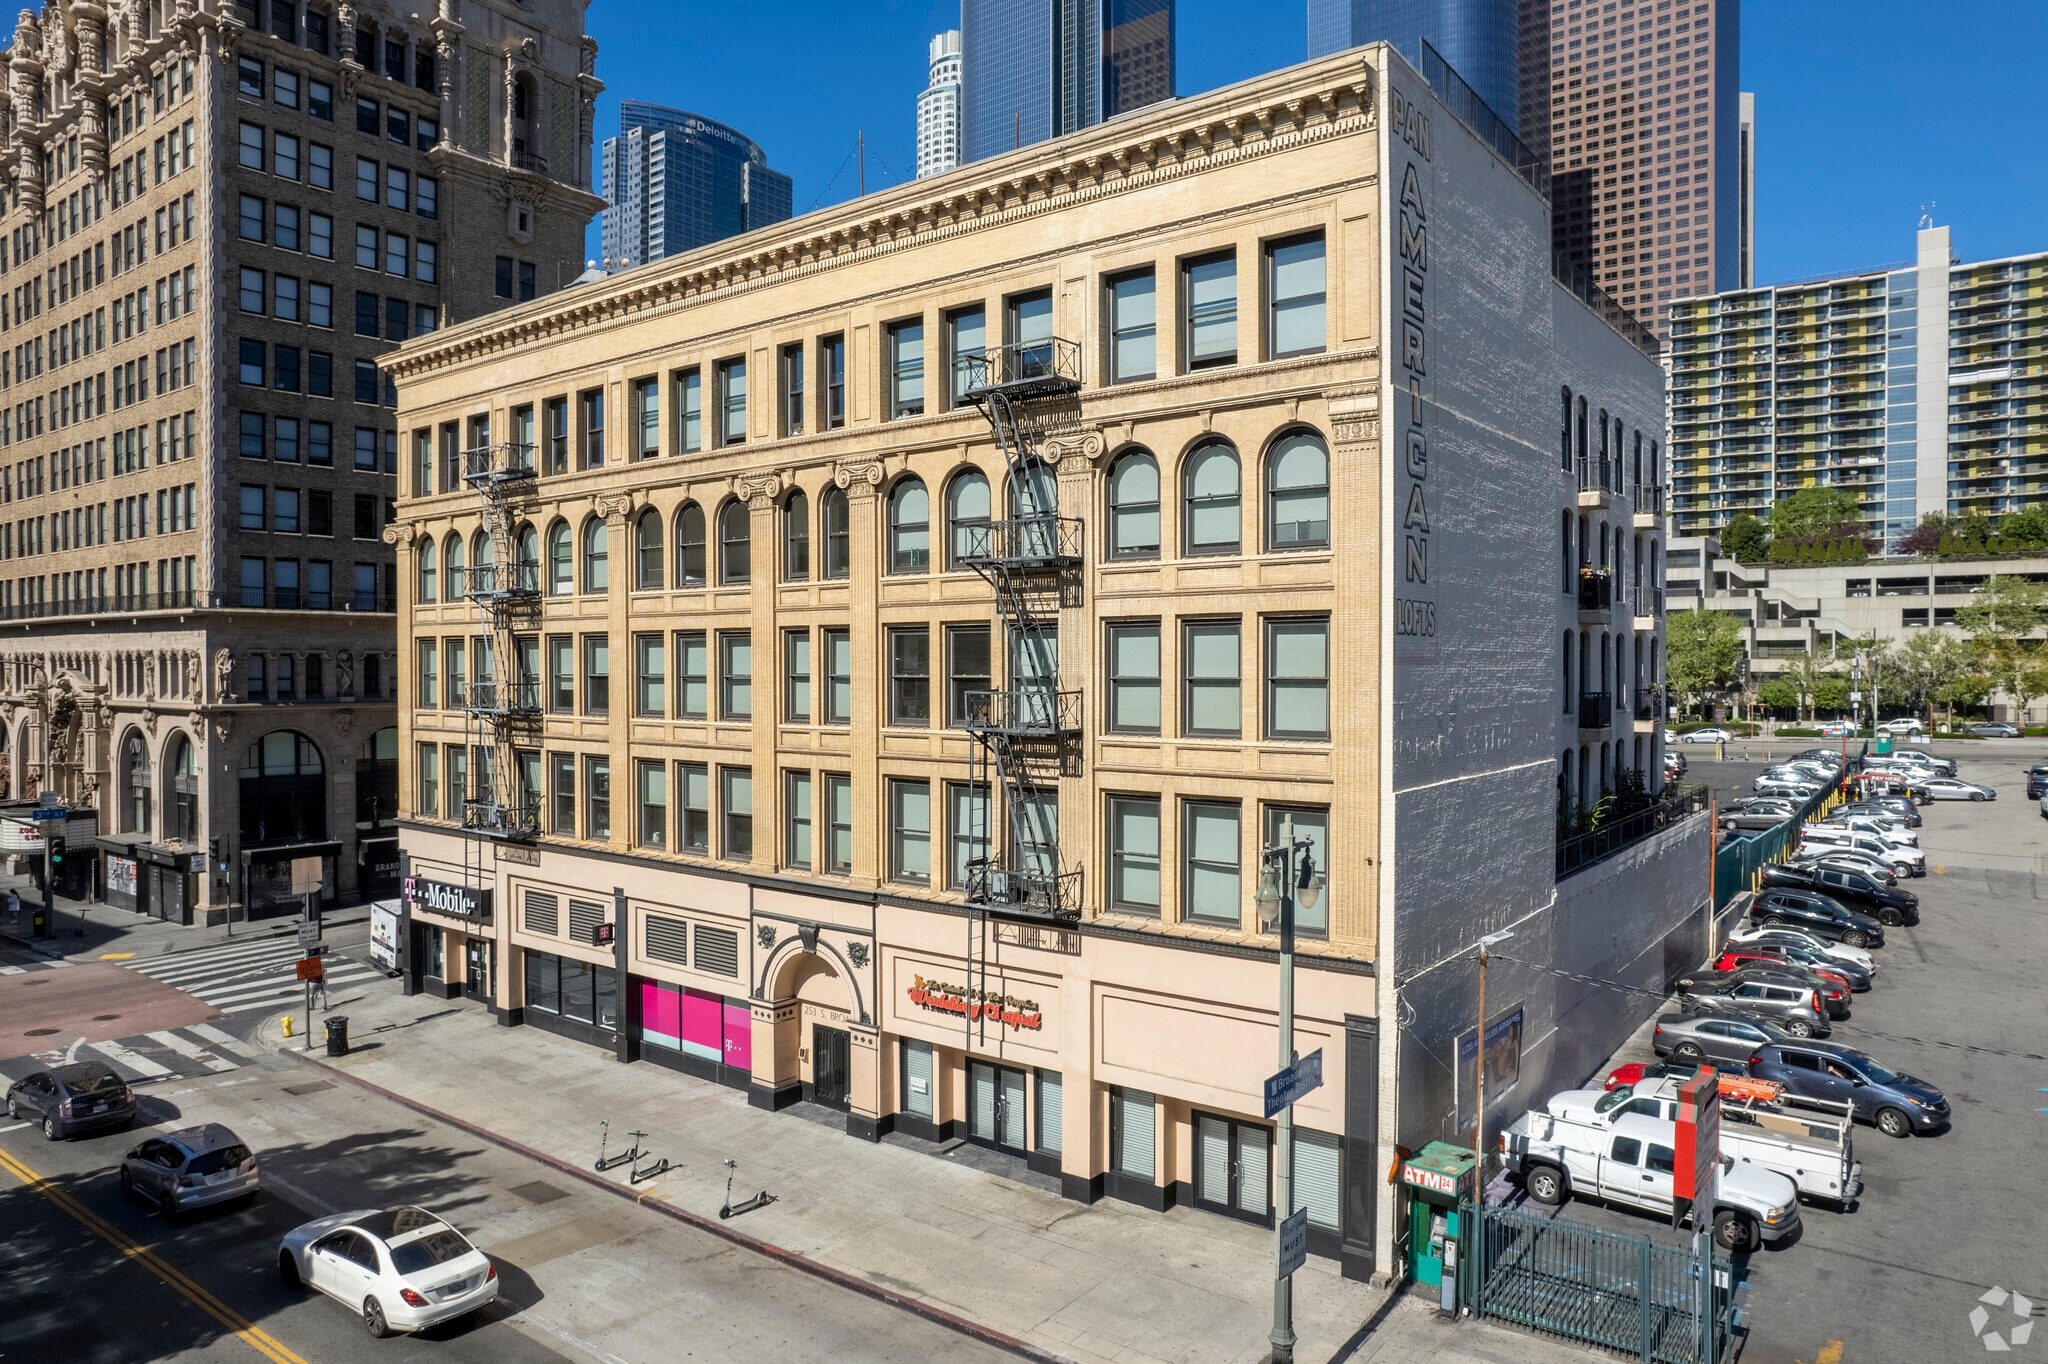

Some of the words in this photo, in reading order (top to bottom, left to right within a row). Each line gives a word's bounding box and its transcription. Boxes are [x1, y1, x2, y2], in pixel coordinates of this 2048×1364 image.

[696, 120, 736, 144] Deloitte
[1391, 86, 1431, 163] PAN
[1400, 161, 1430, 584] AMERICAN
[1396, 598, 1436, 637] LOFTS
[375, 861, 400, 872] GRAND
[804, 1005, 817, 1017] 253
[820, 1009, 827, 1019] S.
[984, 1003, 1041, 1029] Chapel
[1461, 1041, 1474, 1056] LOS
[1473, 1026, 1498, 1048] AELES
[1278, 1063, 1311, 1090] Broadway
[1267, 1088, 1294, 1112] Theater
[1295, 1071, 1320, 1094] District
[1403, 1166, 1440, 1191] ATM
[1442, 1177, 1450, 1188] 24
[1284, 1233, 1303, 1253] MUST
